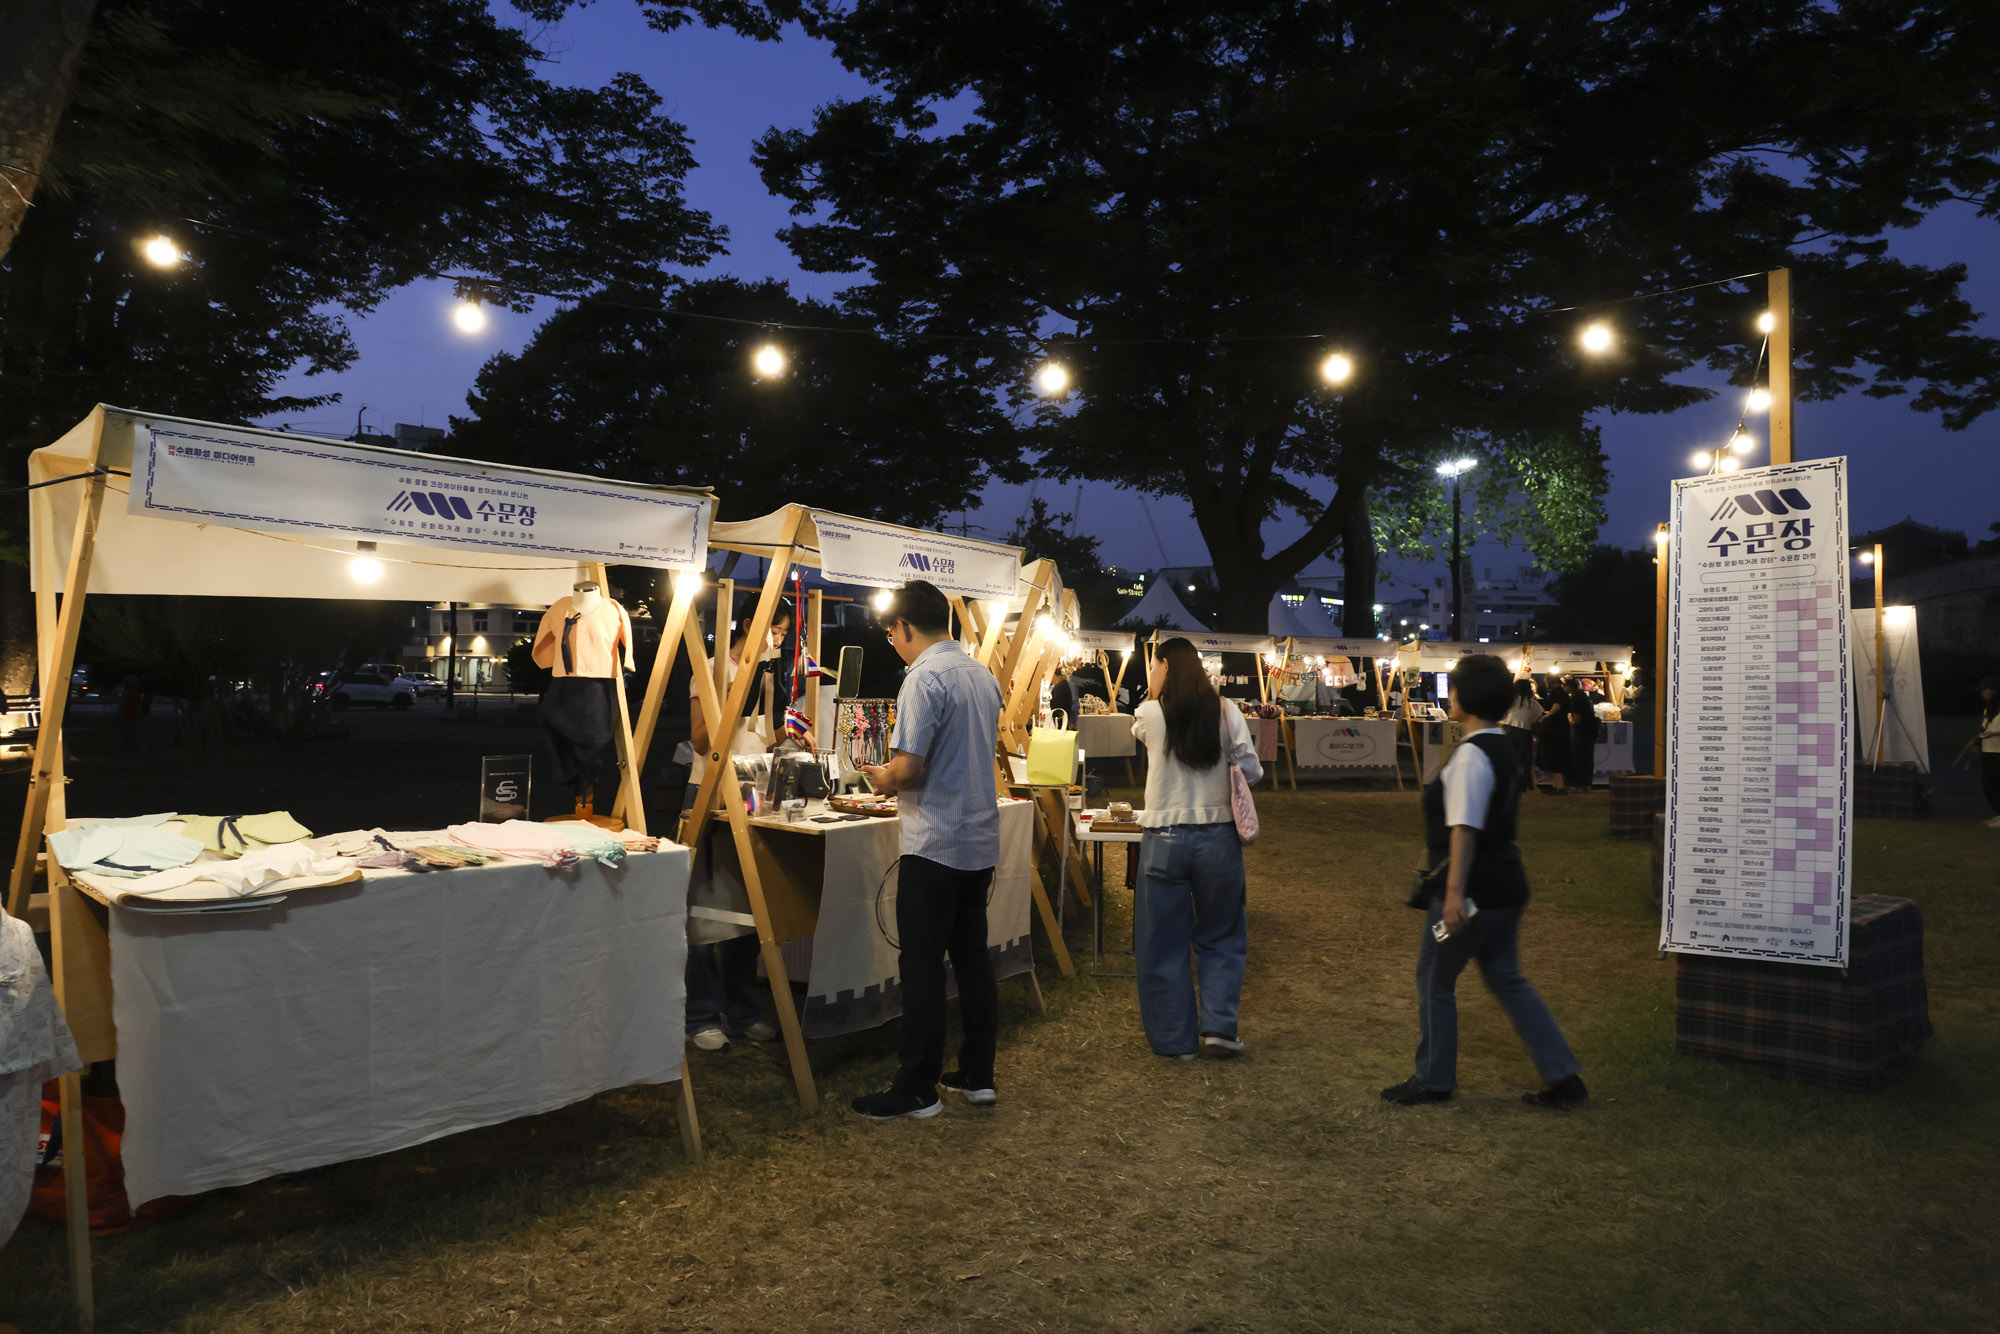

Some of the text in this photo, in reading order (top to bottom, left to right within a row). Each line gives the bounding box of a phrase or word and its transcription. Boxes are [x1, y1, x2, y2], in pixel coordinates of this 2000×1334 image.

[176, 446, 210, 457] 수원화성
[214, 451, 255, 463] 미디어아트
[431, 481, 475, 492] 크리에이터들을
[478, 487, 509, 496] 한자리에서
[511, 492, 529, 500] 만나는
[476, 500, 537, 526] 수문장
[421, 522, 461, 532] 문화직거래
[493, 530, 515, 538] 수문장
[1707, 518, 1815, 557] 수문장
[932, 557, 955, 574] 수문장
[1724, 558, 1758, 567] 문화직거래
[1803, 552, 1816, 560] 마켓
